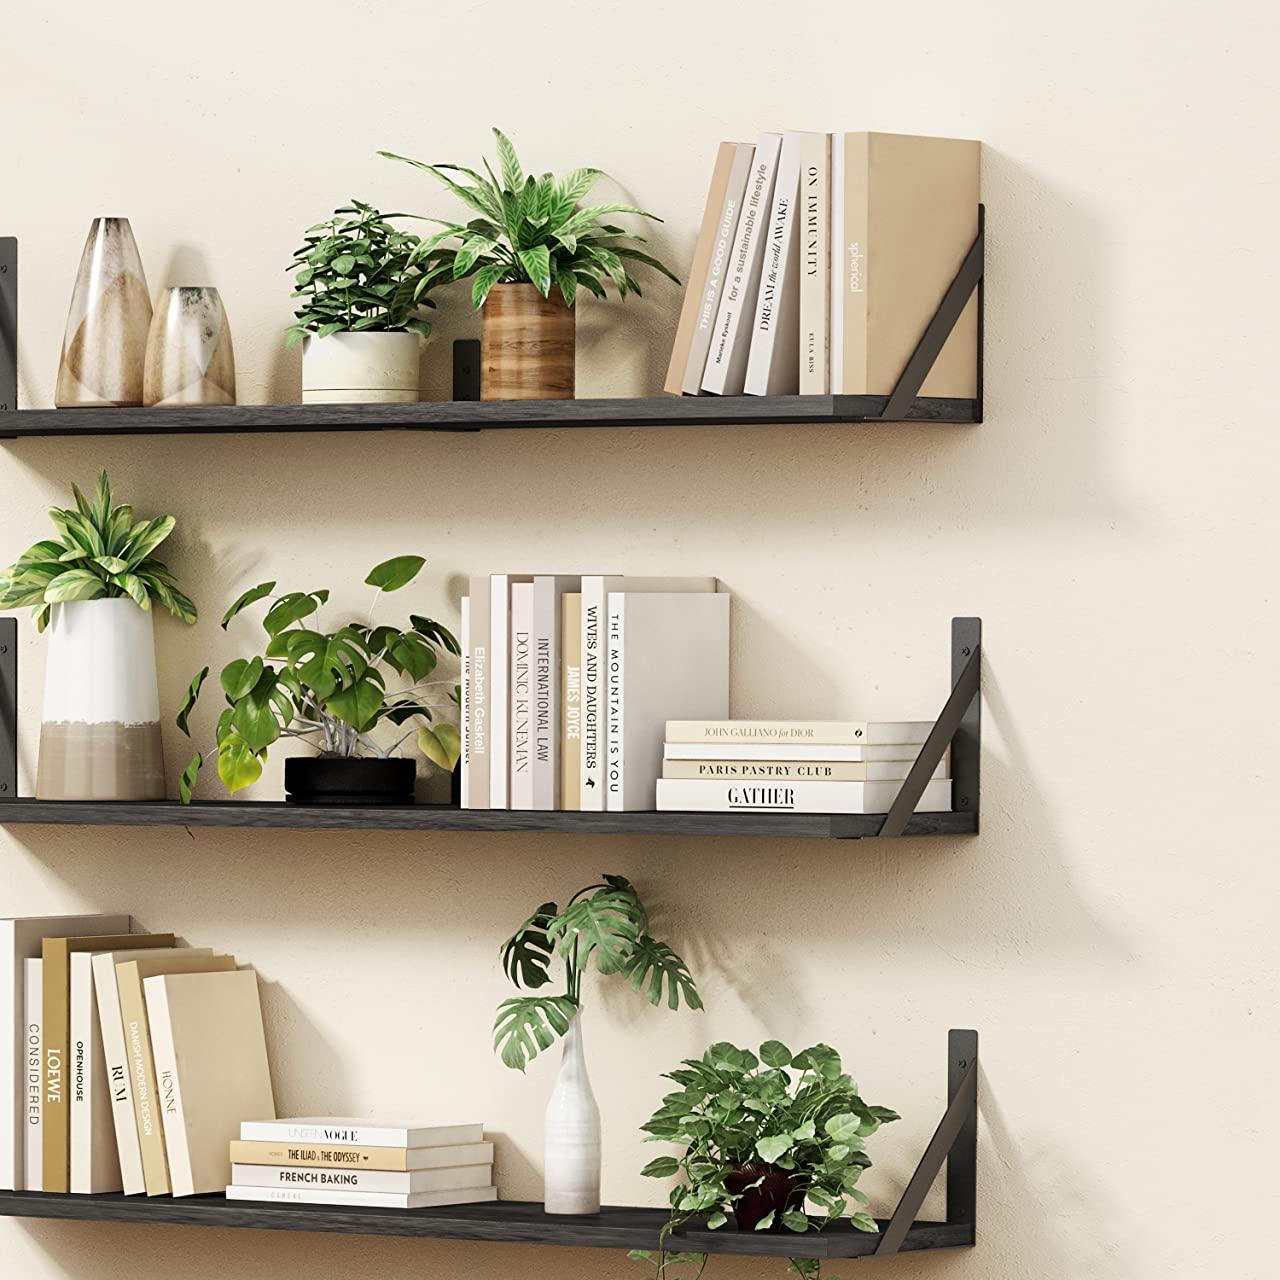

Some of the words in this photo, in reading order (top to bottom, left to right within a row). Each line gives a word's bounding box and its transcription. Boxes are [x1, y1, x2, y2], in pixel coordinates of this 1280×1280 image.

[750, 164, 767, 208] lifestyle
[808, 167, 818, 186] ON
[722, 200, 736, 238] GUIDE
[775, 198, 789, 243] AWAKE
[737, 209, 756, 273] sustainable
[808, 196, 818, 278] IMMUNITY
[712, 240, 726, 276] GOOD
[772, 243, 782, 269] world
[848, 242, 864, 293] spherical
[710, 280, 718, 288] A
[728, 285, 739, 302] for
[734, 276, 741, 284] a
[768, 270, 777, 283] the
[707, 291, 715, 301] IS
[760, 285, 776, 332] DREAM
[700, 303, 712, 329] THIS
[587, 606, 597, 650] WIVES
[611, 615, 619, 640] THE
[475, 648, 485, 704] Elizabeth
[516, 632, 529, 694] DOMINIC
[587, 653, 597, 681] AND
[537, 638, 549, 733] INTERNATIONAL
[568, 666, 580, 704] JAMES
[611, 650, 619, 734] MOUNTAIN
[475, 706, 485, 754] Gaskell
[516, 700, 529, 773] KUNEMAN
[568, 706, 580, 740] JOYCE
[586, 684, 597, 769] DAUGHTERS
[704, 727, 729, 738] JOHN
[730, 727, 778, 738] GALLIANO
[778, 728, 790, 739] for
[790, 728, 814, 738] DIOR
[537, 738, 549, 762] LAW
[611, 740, 619, 754] IS
[610, 761, 619, 793] YOU
[700, 765, 738, 775] PARIS
[742, 766, 792, 776] PASTRY
[798, 767, 833, 777] CLUB
[728, 787, 794, 806] GATHER
[129, 1022, 142, 1058] DANISH
[29, 1024, 40, 1126] CONSIDERED
[48, 1049, 61, 1103] LOEWE
[76, 1041, 84, 1102] OPENHOUSE
[112, 1066, 127, 1101] RUM
[135, 1059, 148, 1102] MODERN
[141, 1102, 153, 1136] DESIGN
[324, 1130, 359, 1142] VOGUE
[288, 1149, 300, 1160] THE
[301, 1151, 316, 1161] ILIAD
[321, 1151, 332, 1162] THE
[333, 1152, 360, 1163] ODYSSEY
[280, 1172, 318, 1183] FRENCH
[321, 1174, 358, 1185] BAKING
